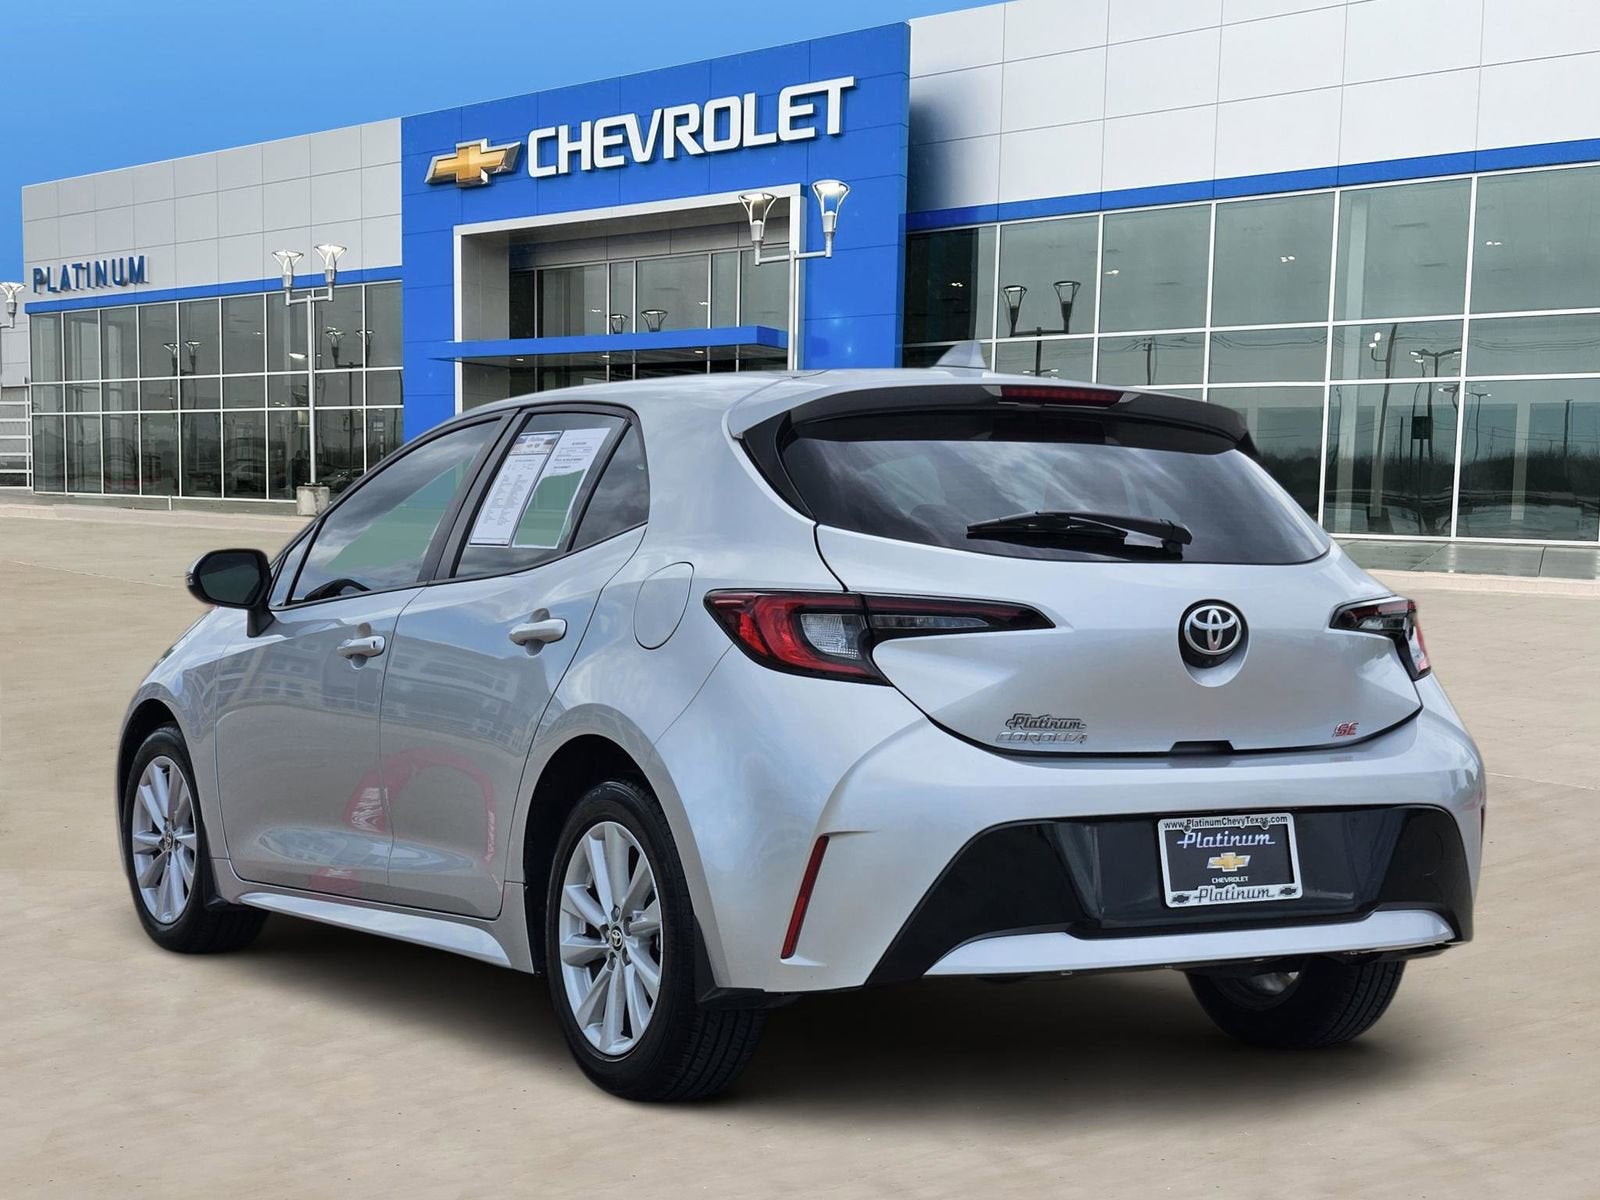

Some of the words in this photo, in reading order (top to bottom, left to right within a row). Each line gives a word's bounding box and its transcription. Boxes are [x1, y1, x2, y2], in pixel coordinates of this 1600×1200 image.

[528, 75, 855, 178] CHEVROLET
[33, 255, 146, 293] PLATINUM
[1006, 713, 1087, 730] Platinum
[1335, 722, 1359, 737] SE
[1164, 815, 1288, 829] www.PlatinumChevyTexas.com
[1177, 831, 1275, 848] Platinum
[1211, 875, 1249, 883] CHEVROLET
[1194, 885, 1275, 902] Platinum
